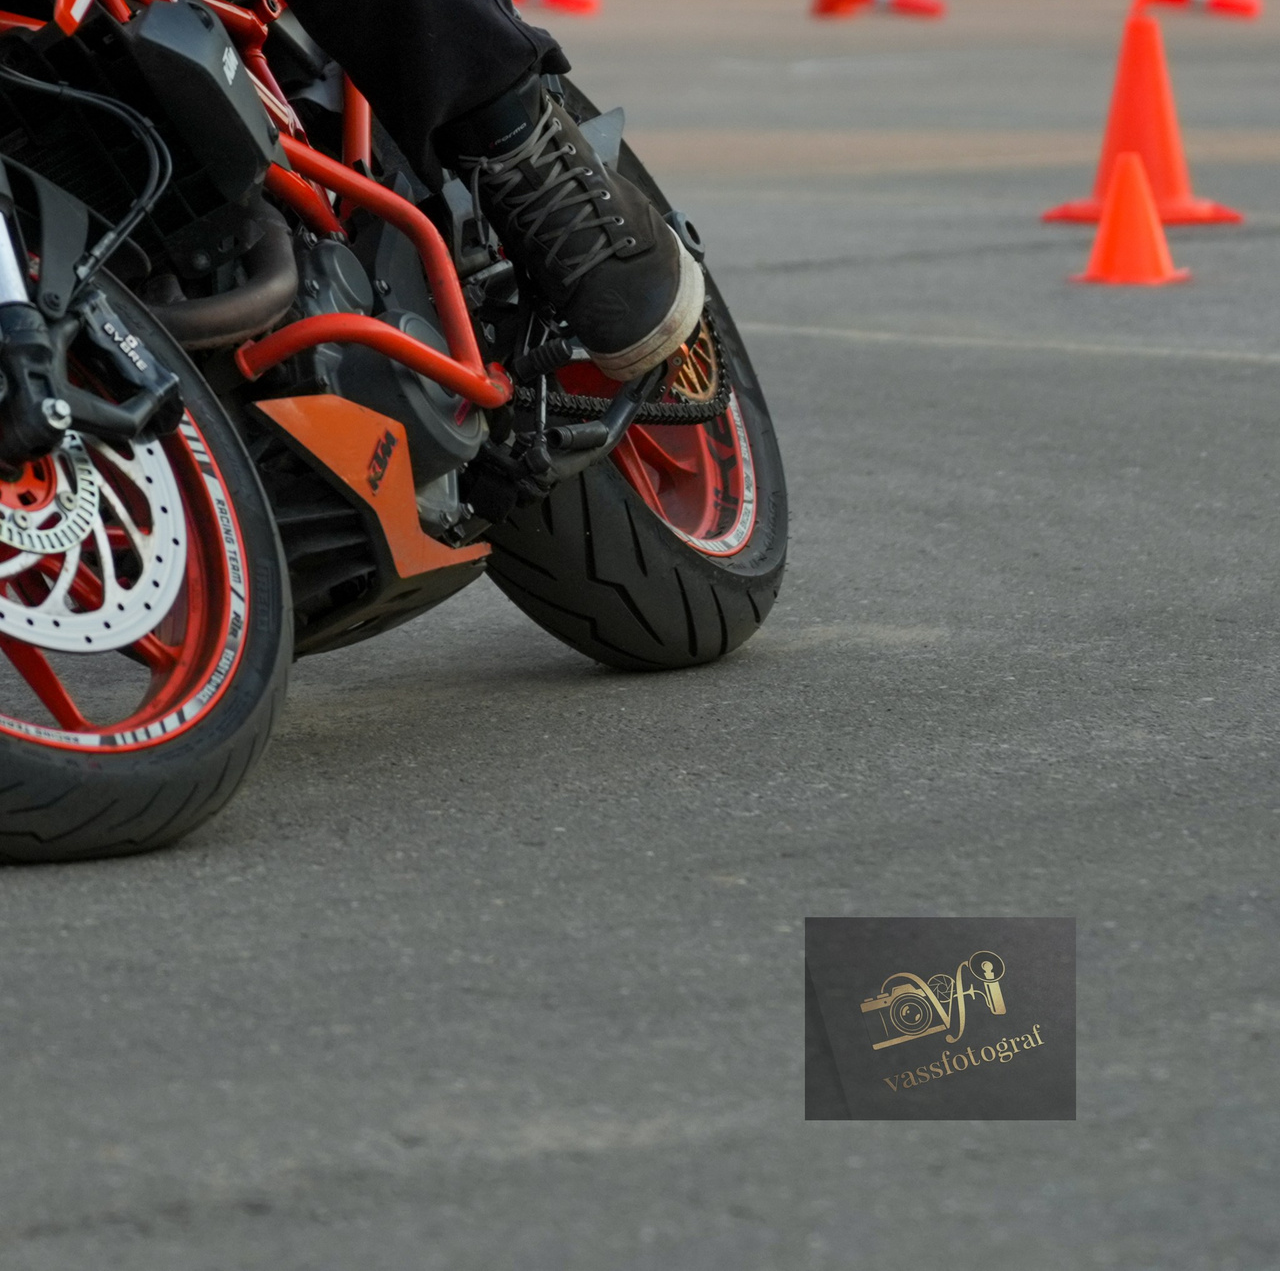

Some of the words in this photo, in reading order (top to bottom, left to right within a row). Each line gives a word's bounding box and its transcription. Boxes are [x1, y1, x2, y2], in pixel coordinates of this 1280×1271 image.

[222, 46, 238, 86] KTM
[103, 322, 148, 371] BYBRE
[368, 429, 397, 496] KTM
[215, 498, 235, 544] RACING
[227, 547, 242, 584] TEAM
